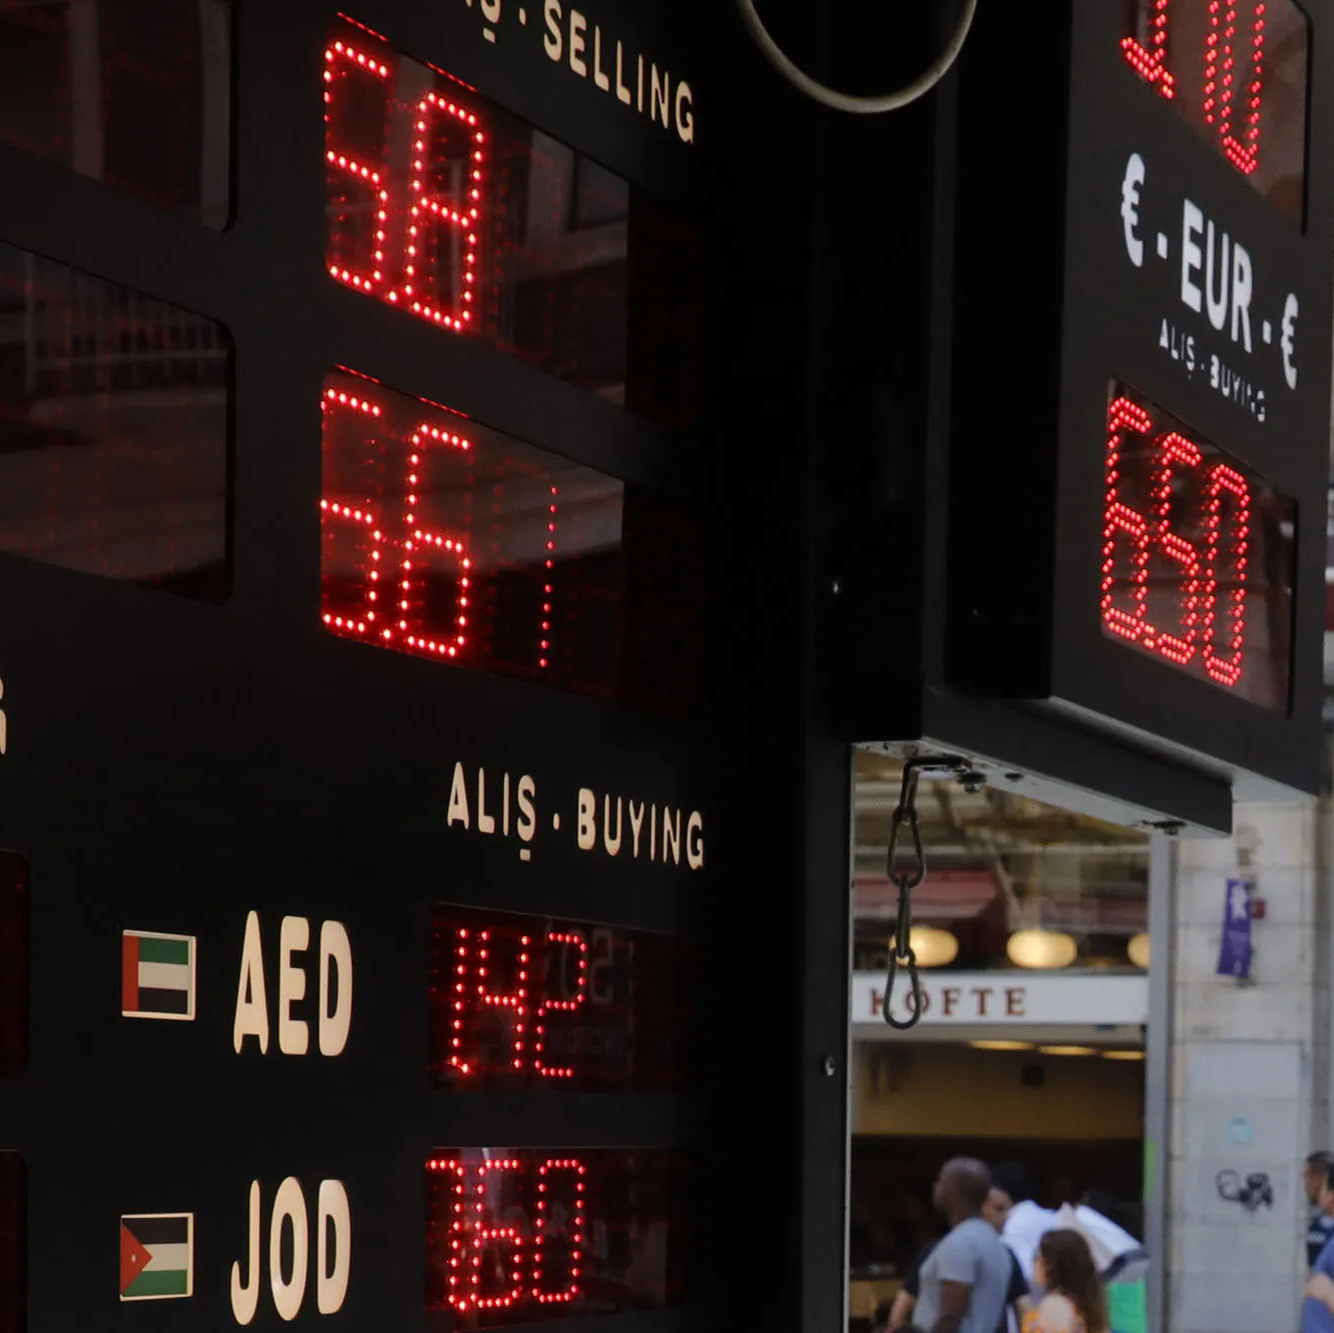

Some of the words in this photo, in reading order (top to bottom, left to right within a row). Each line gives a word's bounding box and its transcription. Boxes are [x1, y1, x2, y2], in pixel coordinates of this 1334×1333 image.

[543, 0, 693, 143] SELLING
[1175, 199, 1253, 355] EUR
[447, 761, 536, 861] ALIŞ
[577, 787, 705, 870] BUYING
[233, 910, 354, 1057] AED
[230, 1176, 351, 1326] JOD
